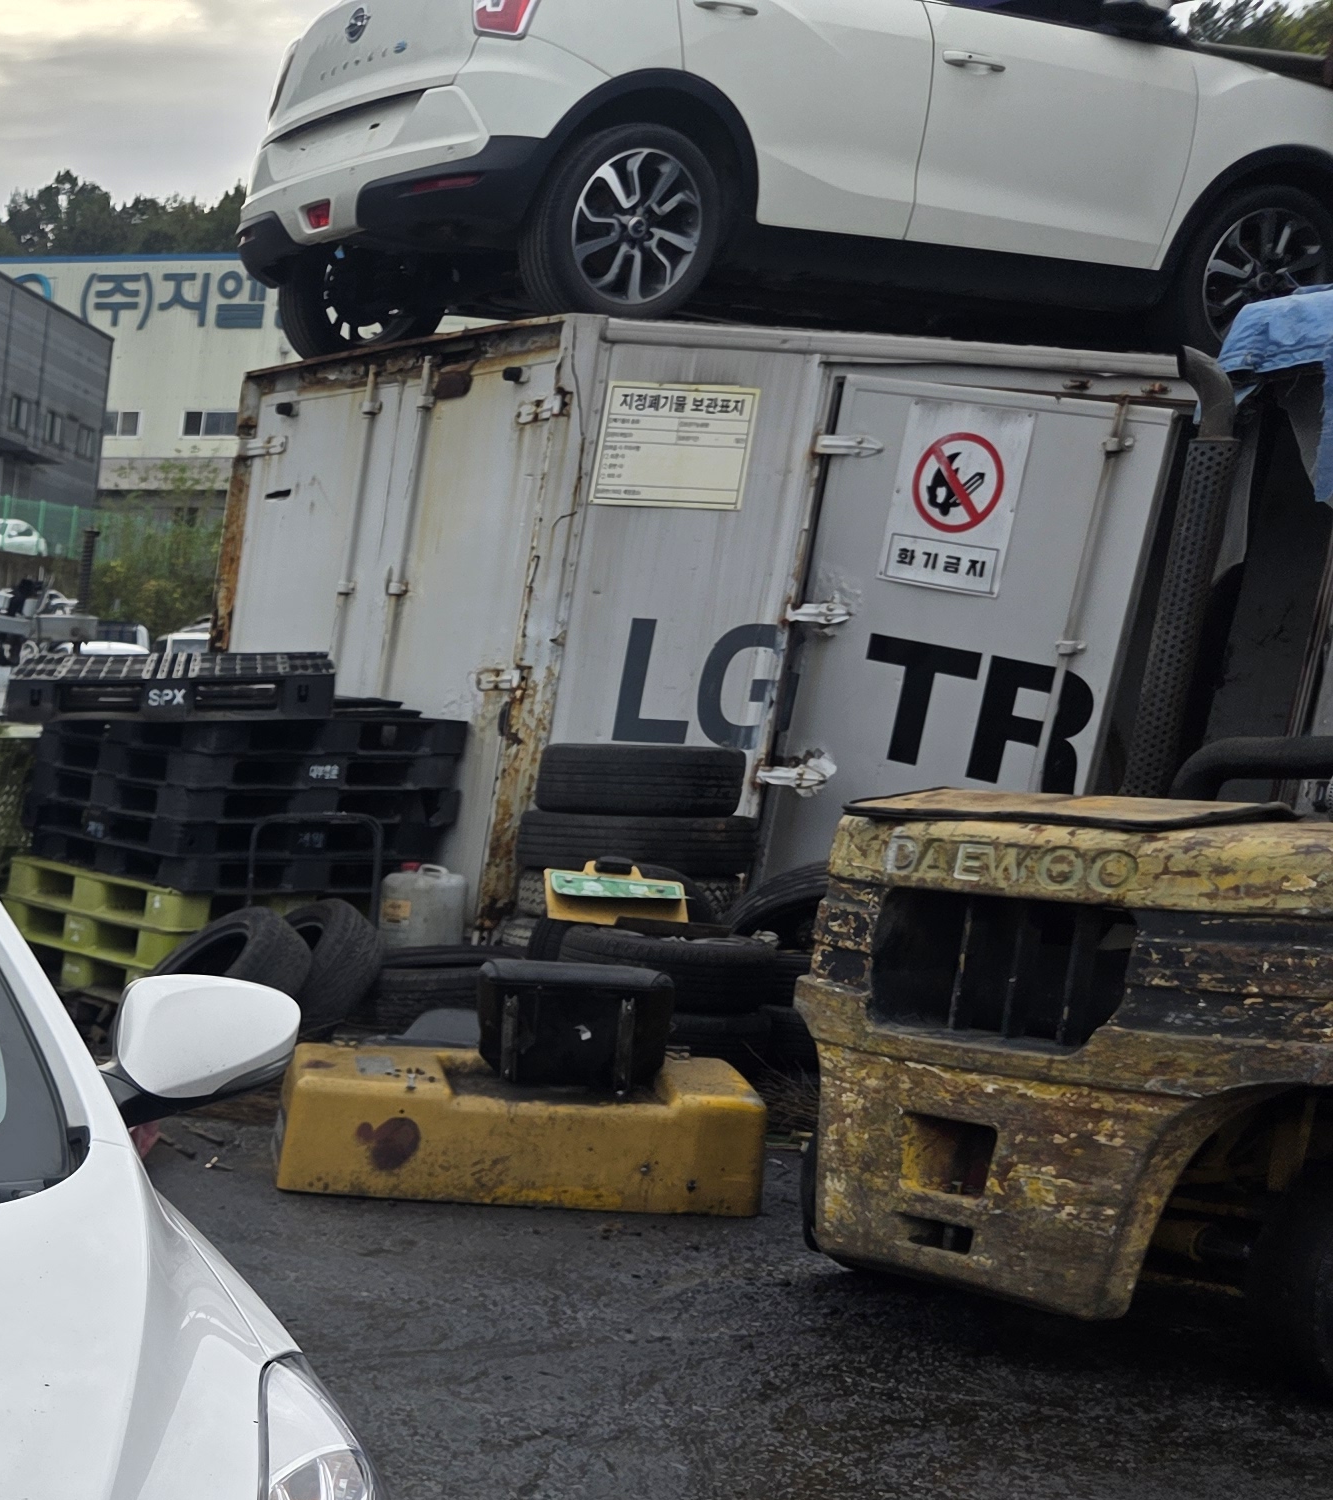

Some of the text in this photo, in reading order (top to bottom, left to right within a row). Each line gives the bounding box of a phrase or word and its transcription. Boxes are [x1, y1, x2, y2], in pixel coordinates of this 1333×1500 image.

[81, 270, 284, 331] (주)지엘
[620, 393, 745, 416] 지정폐기물 보관표지
[148, 689, 186, 706] SPX
[886, 833, 1138, 895] DAEWOO
